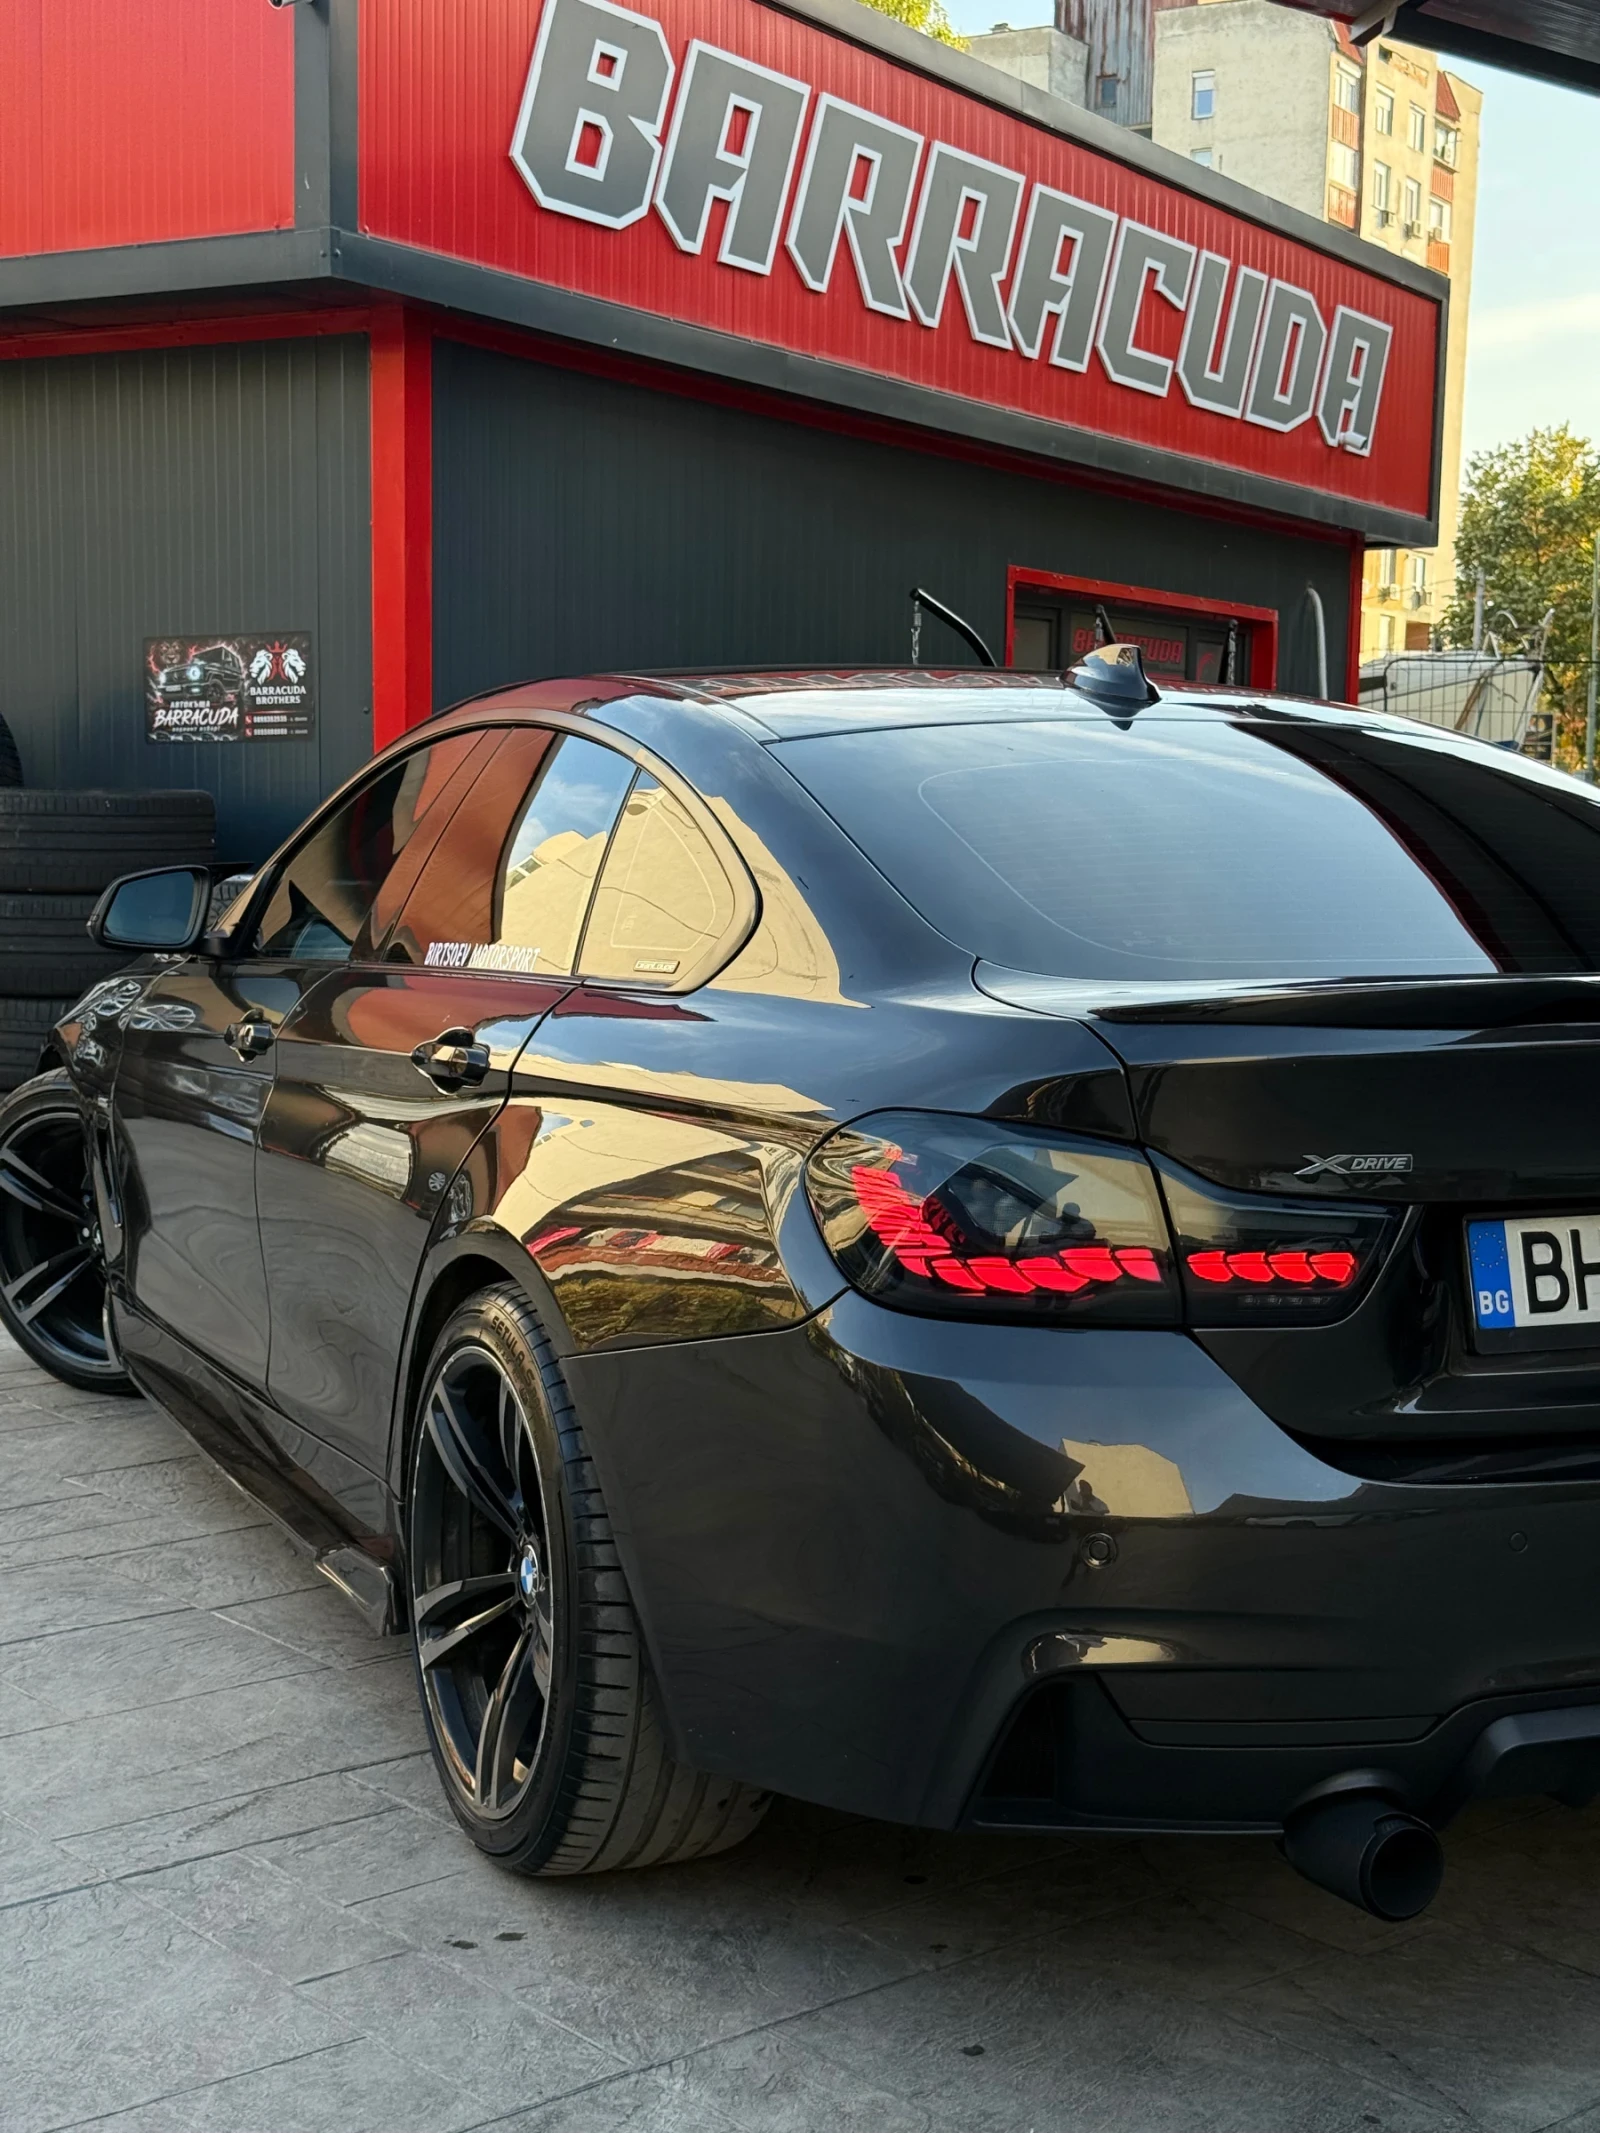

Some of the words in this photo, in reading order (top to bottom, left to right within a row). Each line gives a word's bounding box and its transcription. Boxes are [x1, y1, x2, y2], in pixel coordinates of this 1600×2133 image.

[510, 0, 1393, 457] BARRACUDA
[1072, 628, 1184, 663] BACUDA
[250, 685, 306, 696] BARRACUDA
[255, 696, 301, 705] BROTHERS
[153, 707, 239, 729] BARRACUDA
[467, 943, 541, 972] MOTORSPORT
[1479, 1290, 1509, 1315] BG
[490, 1315, 526, 1367] SETULA
